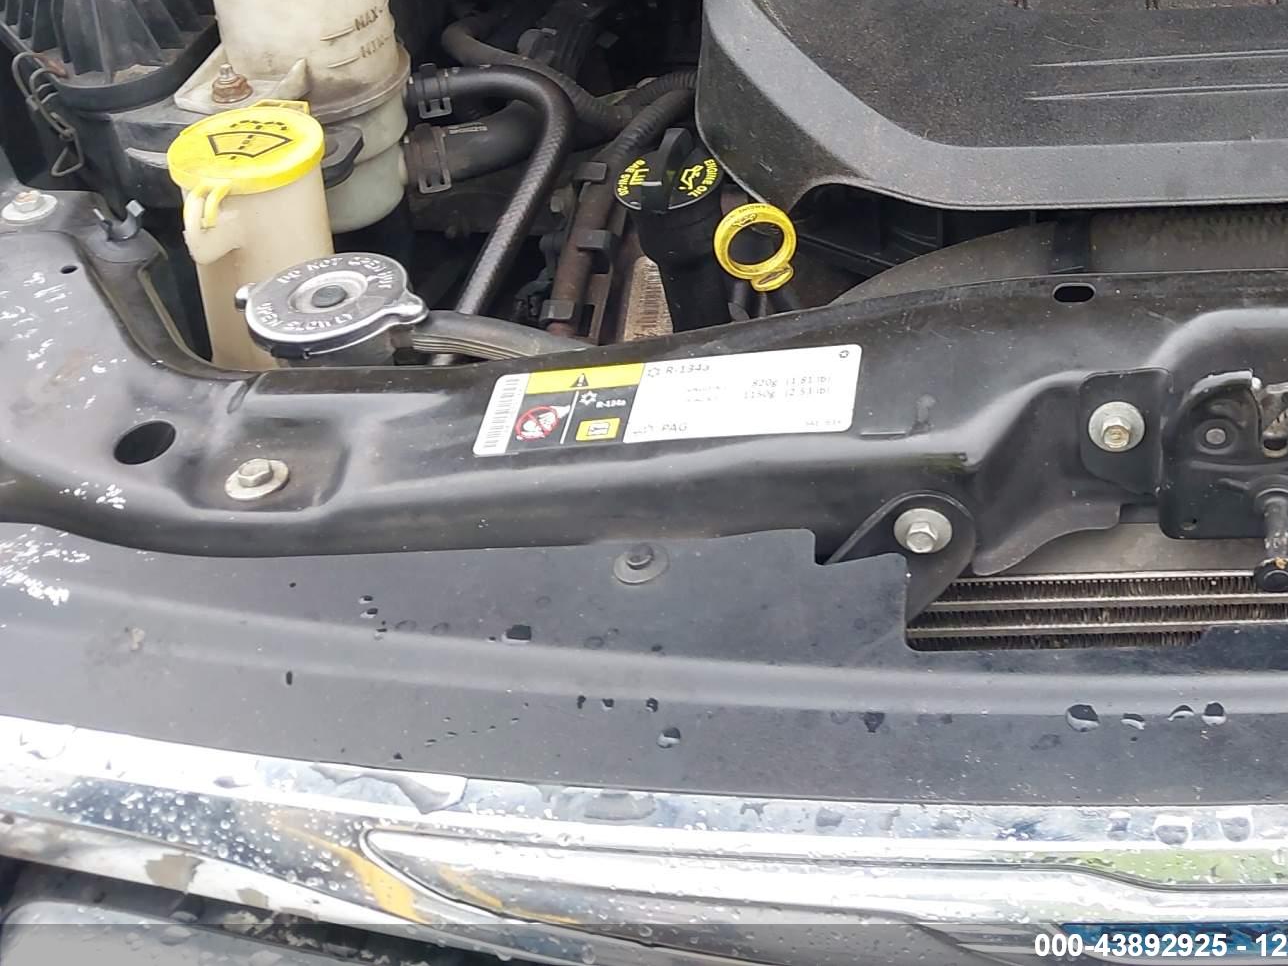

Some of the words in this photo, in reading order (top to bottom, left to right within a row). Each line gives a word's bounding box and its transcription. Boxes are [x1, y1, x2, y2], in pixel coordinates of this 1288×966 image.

[703, 159, 718, 186] ENGINE
[686, 185, 708, 198] OIL
[306, 257, 343, 272] NOT
